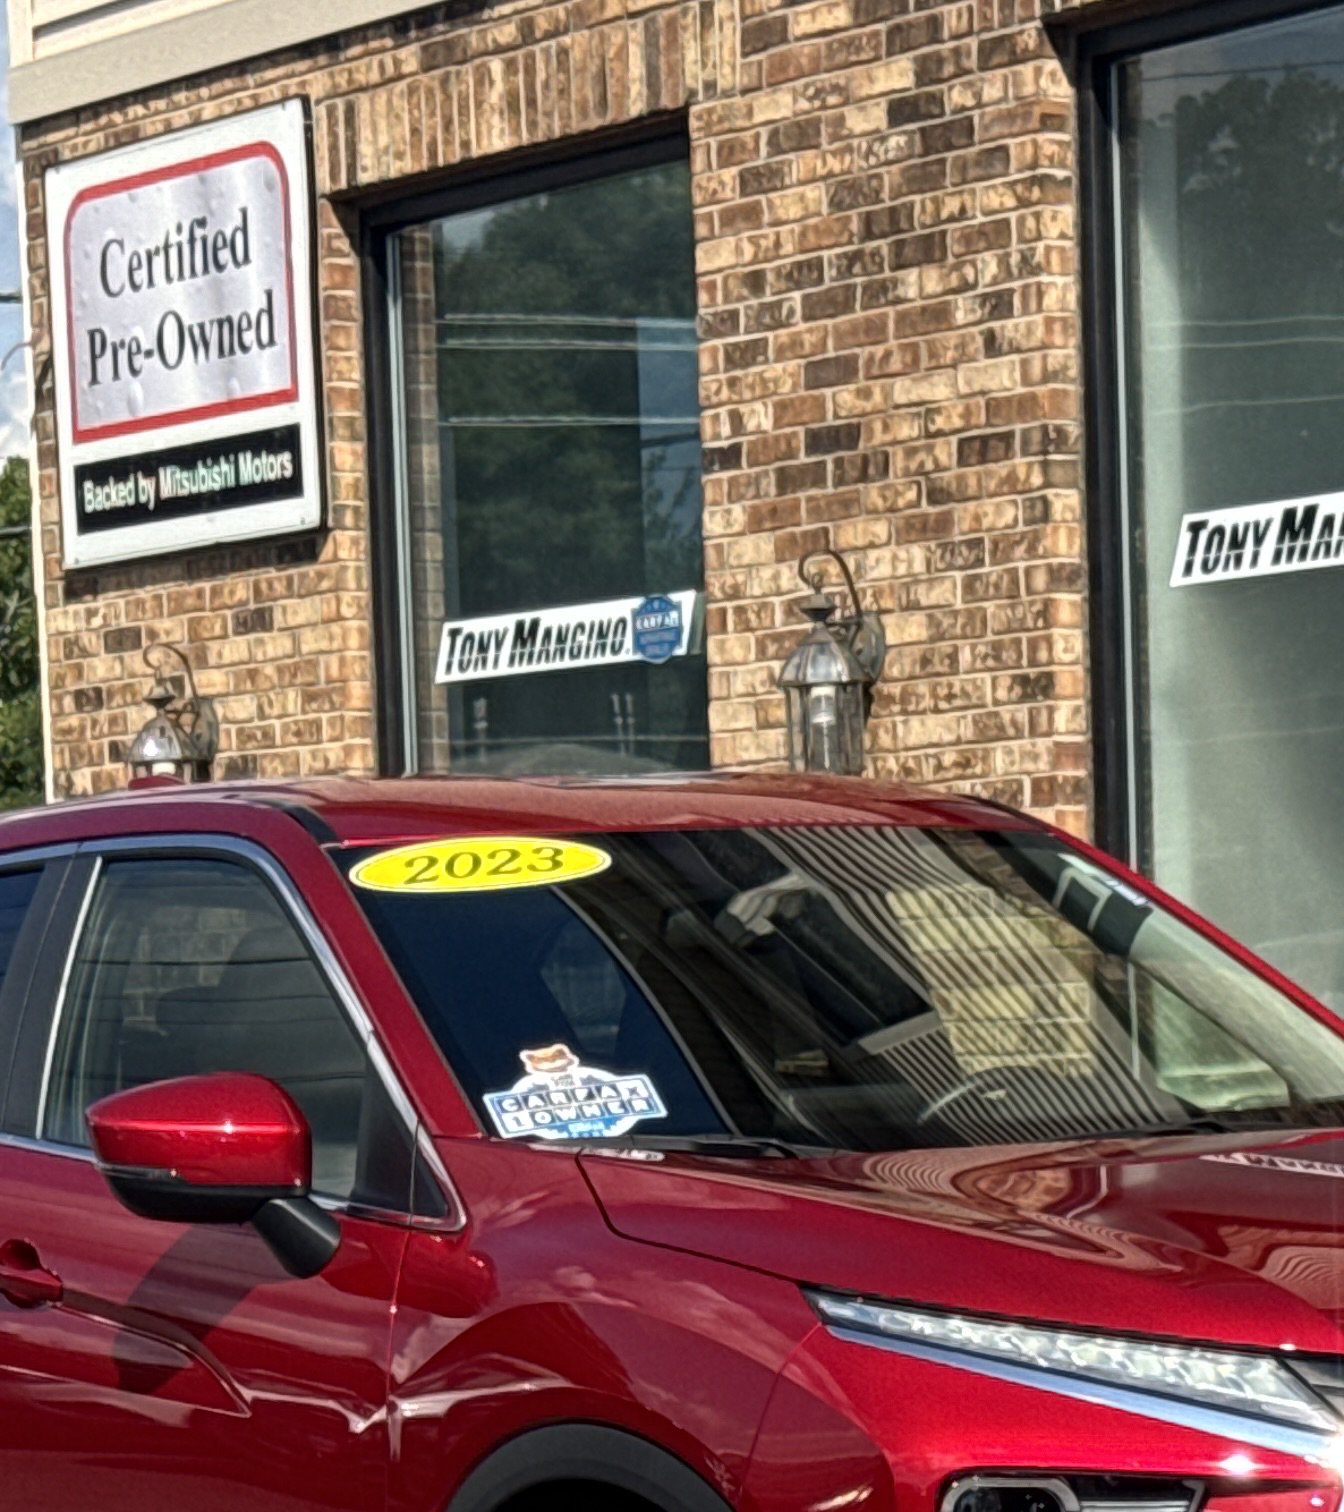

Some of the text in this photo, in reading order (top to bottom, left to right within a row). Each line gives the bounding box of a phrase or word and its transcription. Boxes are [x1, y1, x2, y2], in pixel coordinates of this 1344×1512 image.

[99, 206, 253, 299] Certified
[86, 289, 277, 388] Pre-Owned
[83, 448, 293, 514] Backed by Mitsubishi Motors
[1182, 517, 1274, 578] TONY
[444, 625, 509, 676] TONY
[404, 846, 564, 885] 2023
[498, 1083, 643, 1112] CARFAX
